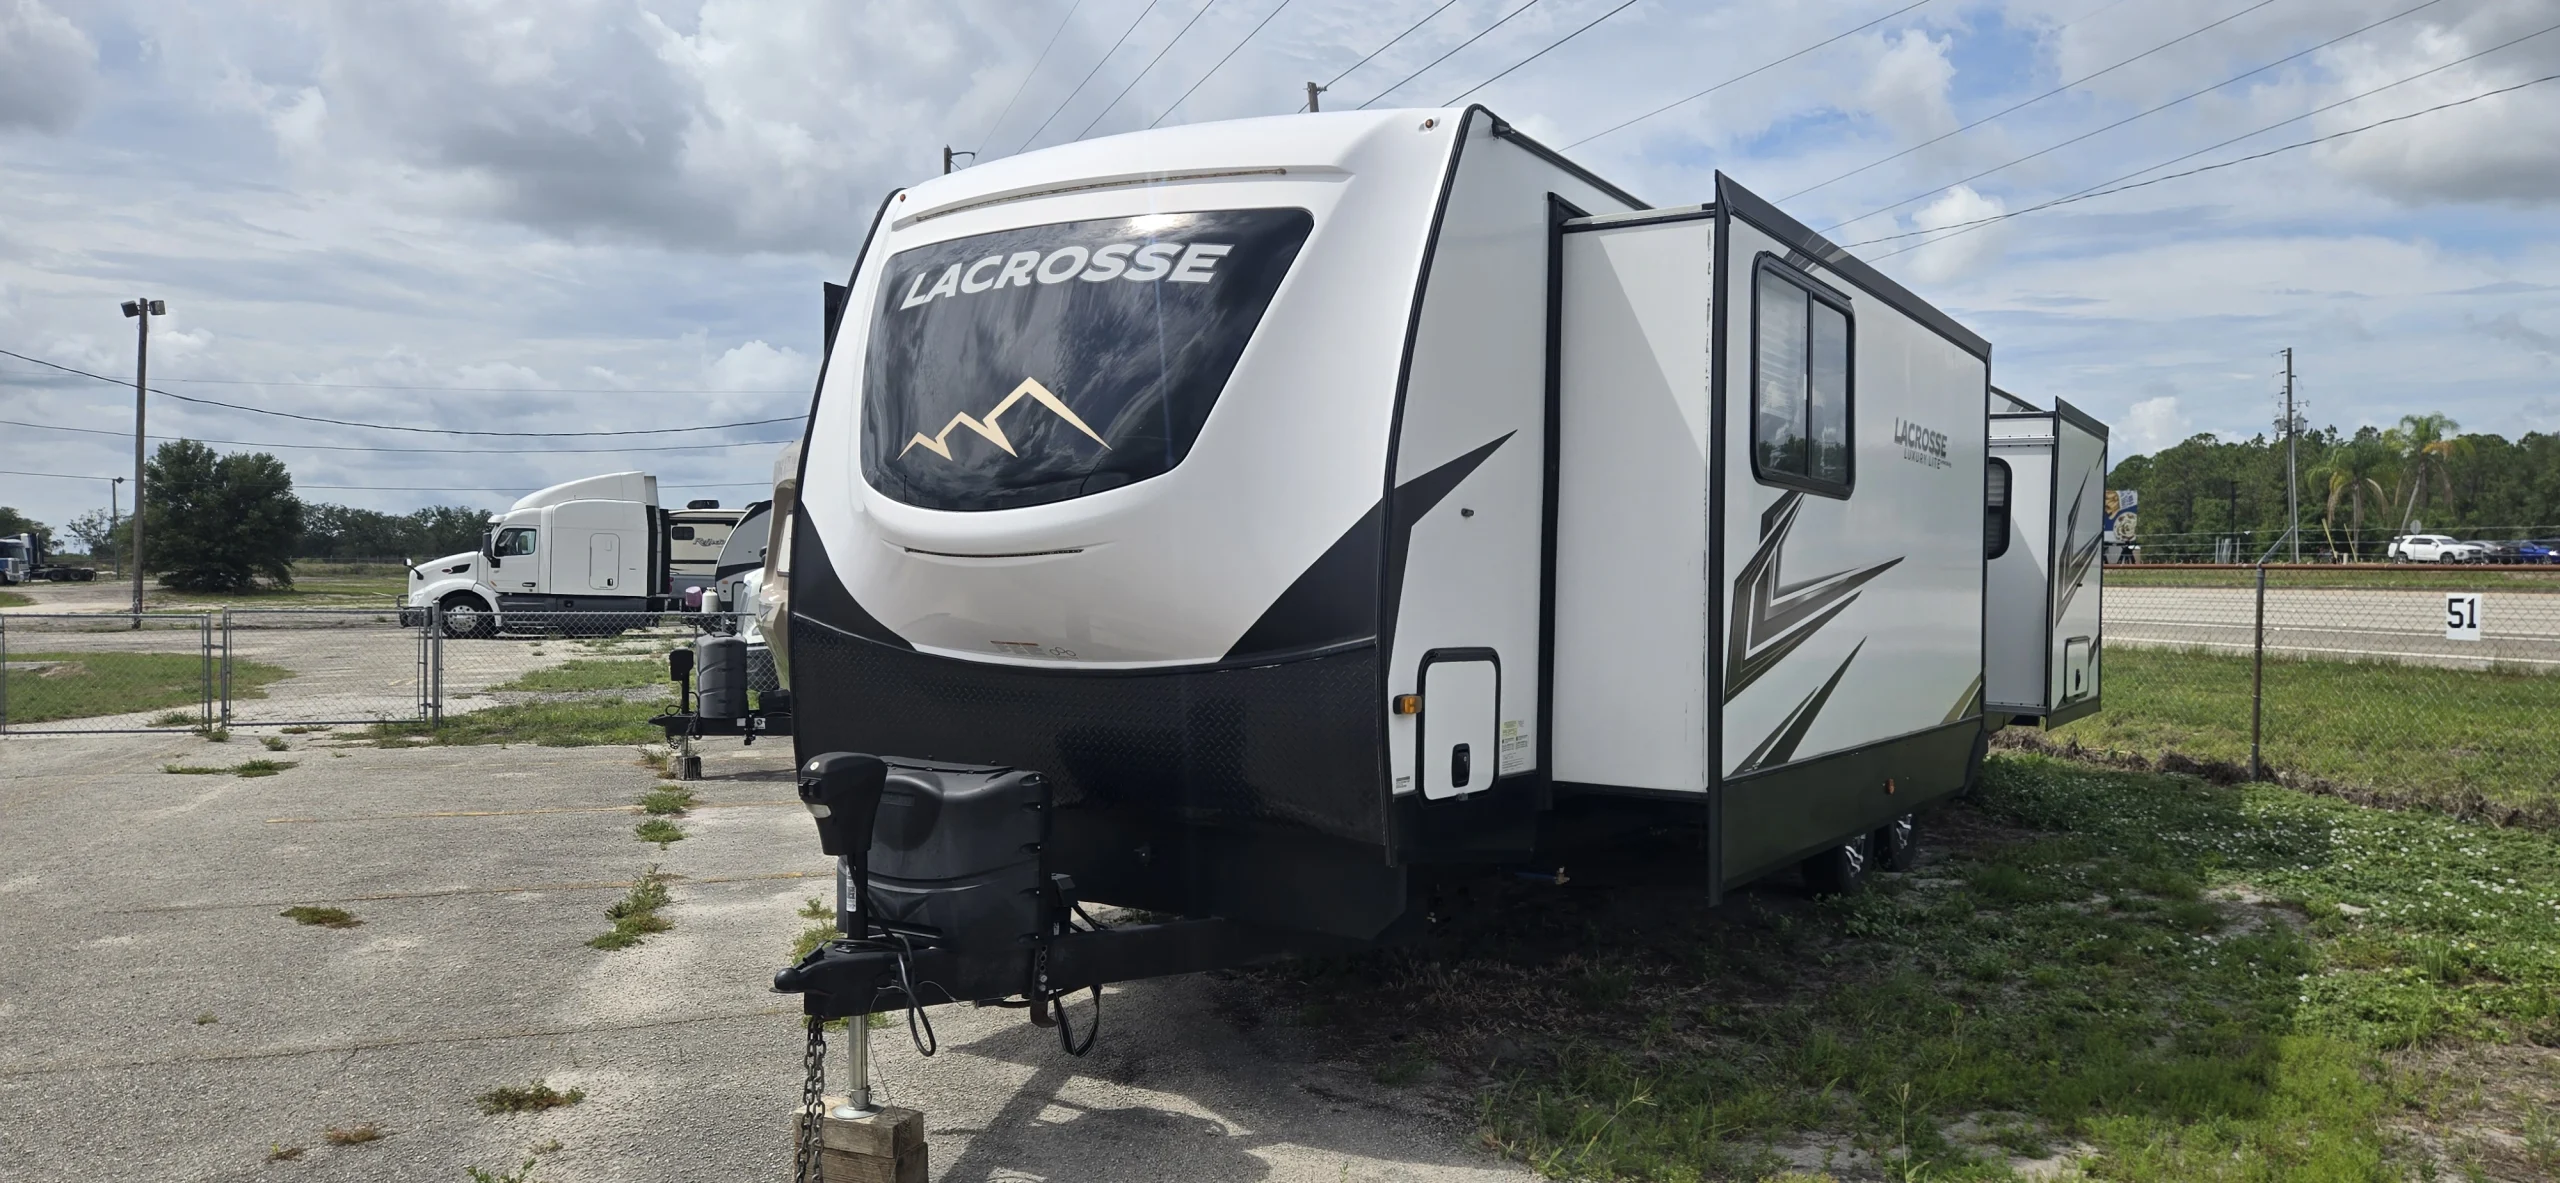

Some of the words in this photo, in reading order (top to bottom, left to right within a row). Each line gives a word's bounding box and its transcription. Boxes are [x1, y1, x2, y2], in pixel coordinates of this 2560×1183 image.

[899, 243, 1235, 311] LACROSSE
[1894, 417, 1948, 459] LACROSSE
[1904, 447, 1927, 465] LUXURY
[1928, 455, 1940, 470] LITE
[2447, 598, 2477, 629] 51
